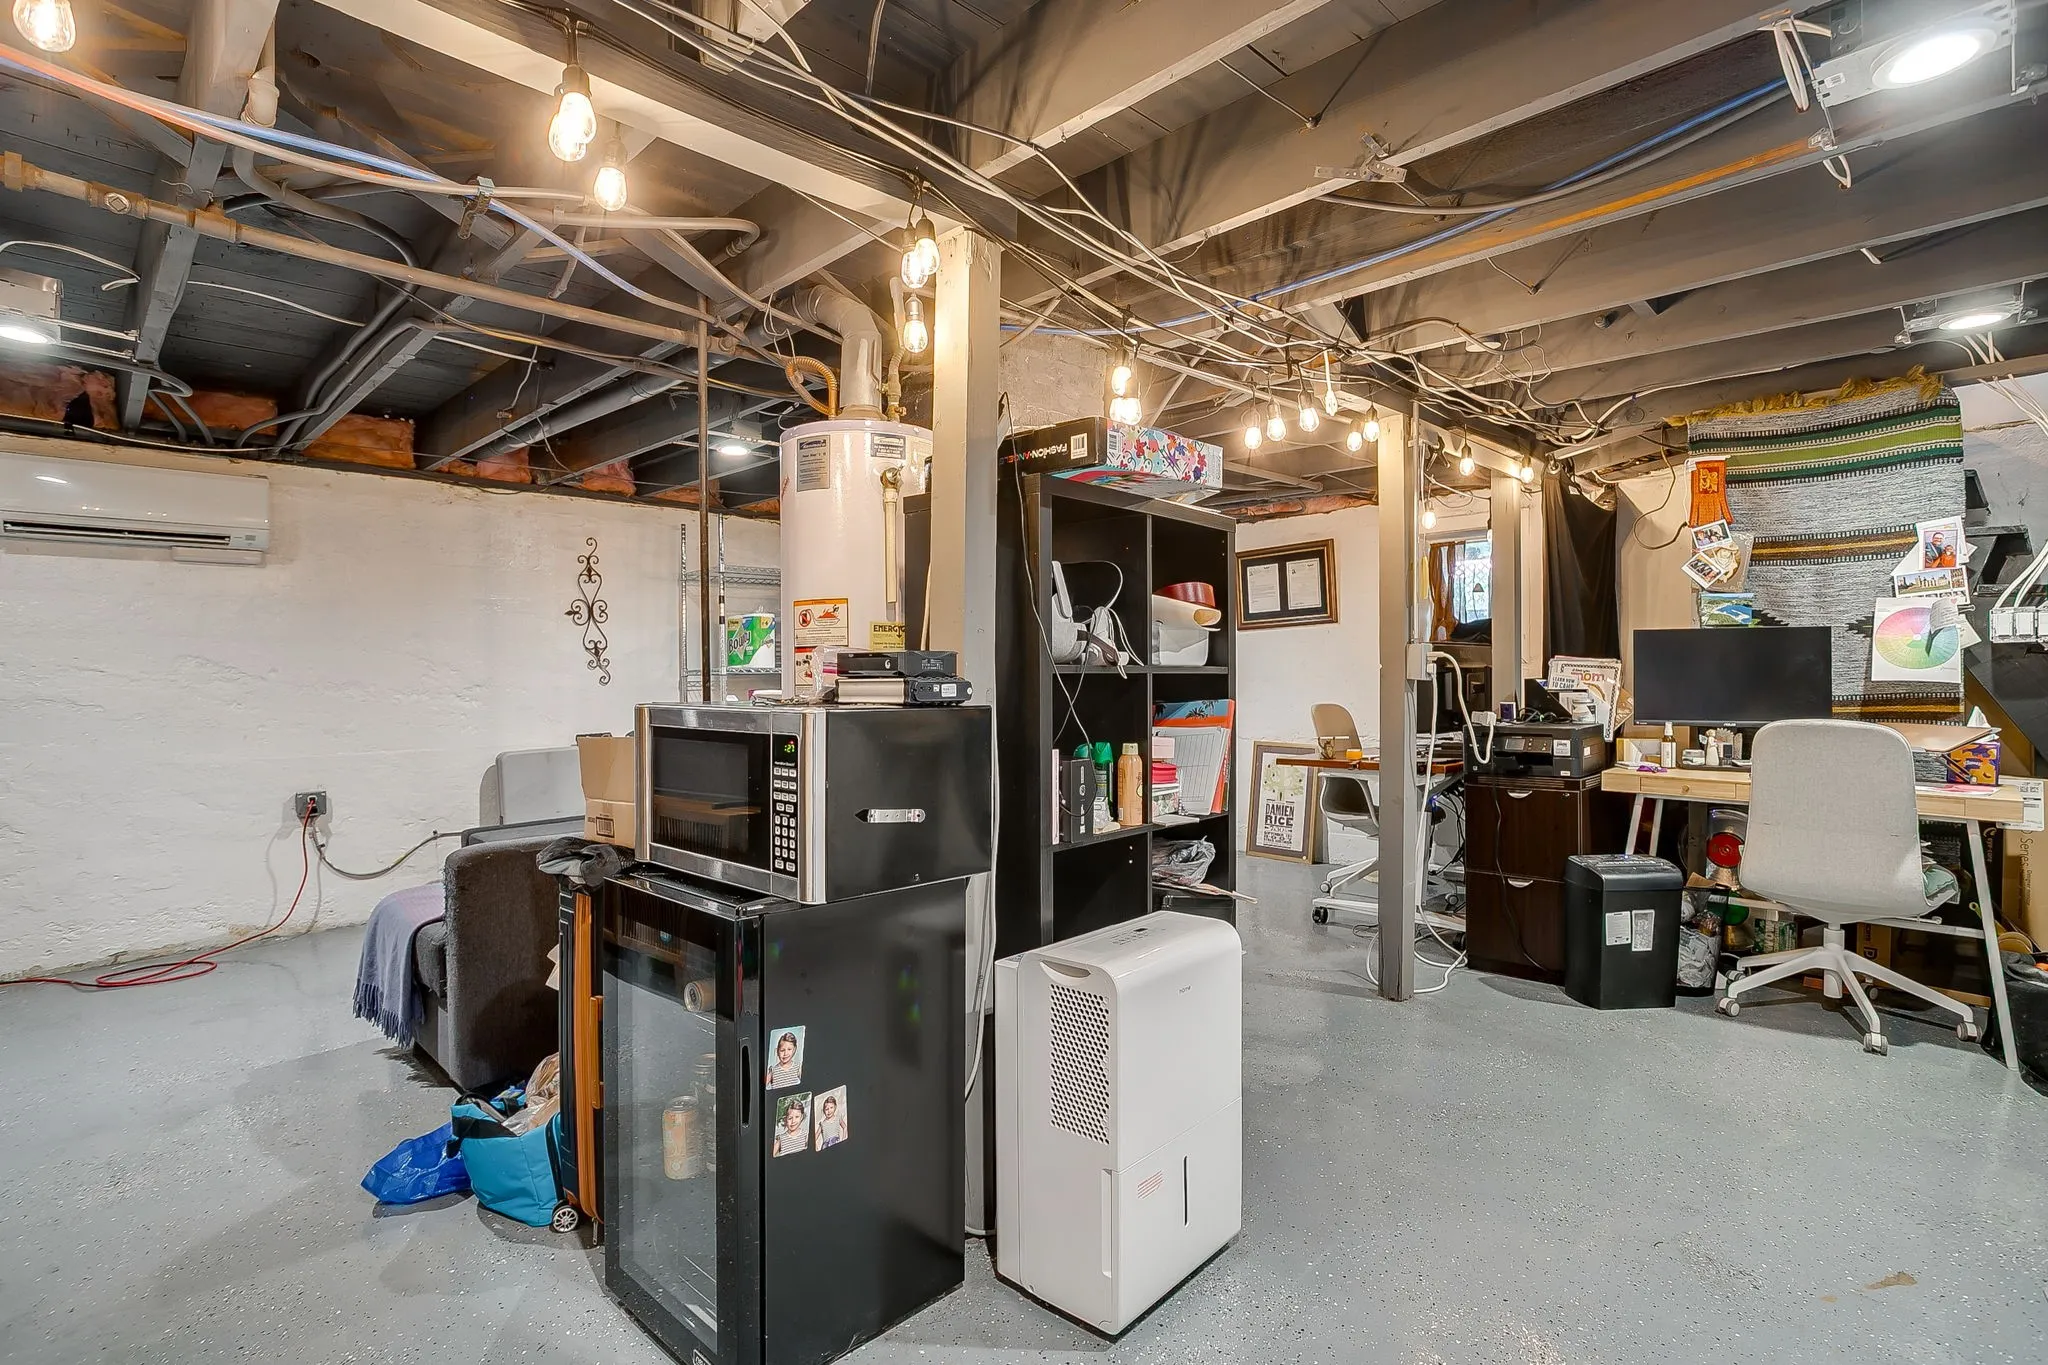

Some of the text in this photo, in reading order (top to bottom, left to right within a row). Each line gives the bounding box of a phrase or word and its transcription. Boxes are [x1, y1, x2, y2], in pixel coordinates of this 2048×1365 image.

[1265, 803, 1295, 817] DAMIEN
[1264, 815, 1294, 826] RICE
[2020, 838, 2033, 867] Series
